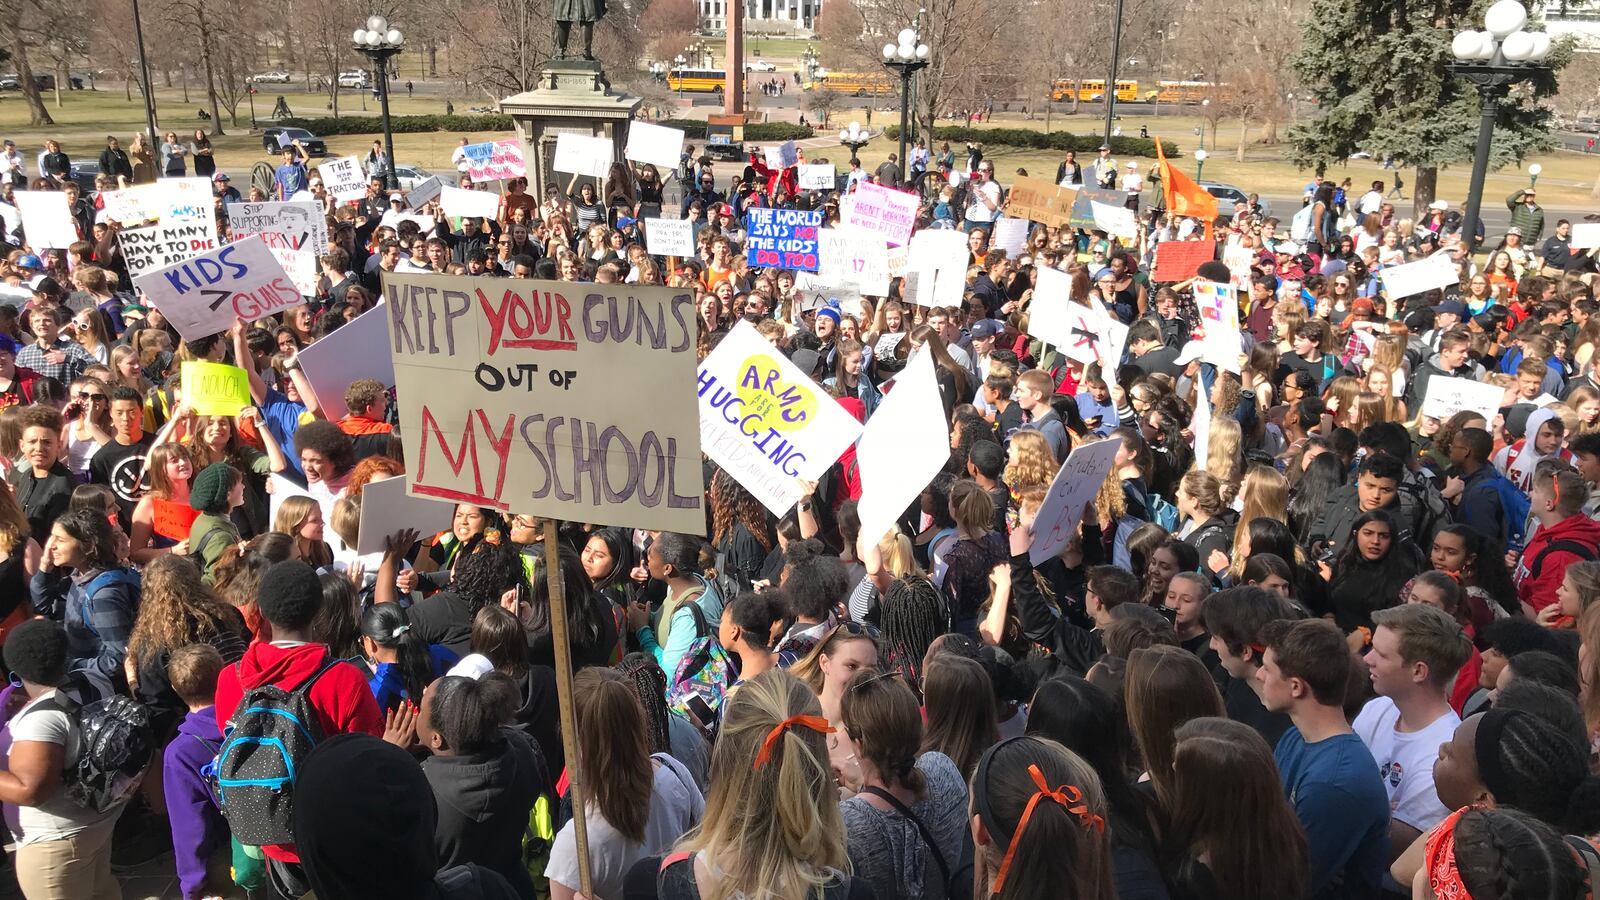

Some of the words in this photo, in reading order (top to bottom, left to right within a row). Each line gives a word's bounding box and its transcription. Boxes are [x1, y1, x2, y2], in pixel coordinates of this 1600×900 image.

[329, 160, 352, 173] THE
[327, 182, 366, 195] TRAITORS
[243, 204, 263, 215] STOP
[749, 209, 774, 225] THE
[776, 210, 821, 227] WORLD
[231, 215, 279, 230] SUPPORTING
[754, 224, 789, 237] SAYS
[850, 217, 860, 226] WE
[120, 230, 156, 245] HOW
[163, 226, 207, 241] MANY
[123, 243, 163, 258] HAVE
[166, 241, 187, 253] TO
[190, 239, 215, 252] DIE
[748, 237, 774, 251] THE
[777, 239, 816, 254] KIDS
[127, 255, 154, 271] FOR
[784, 253, 816, 268] TOO
[852, 259, 865, 272] 17
[164, 246, 248, 295] KIDS
[231, 278, 300, 320] GUNS
[388, 284, 471, 357] KEEP
[475, 288, 575, 356] YOUR
[582, 293, 692, 353] GUNS
[475, 362, 538, 391] OUT
[549, 369, 578, 390] OF
[741, 364, 807, 424] ARMS
[753, 394, 775, 412] ARE
[749, 401, 770, 419] FOR
[697, 369, 807, 478] HUGGING
[416, 405, 516, 501] MY
[520, 413, 700, 509] SCHOOL
